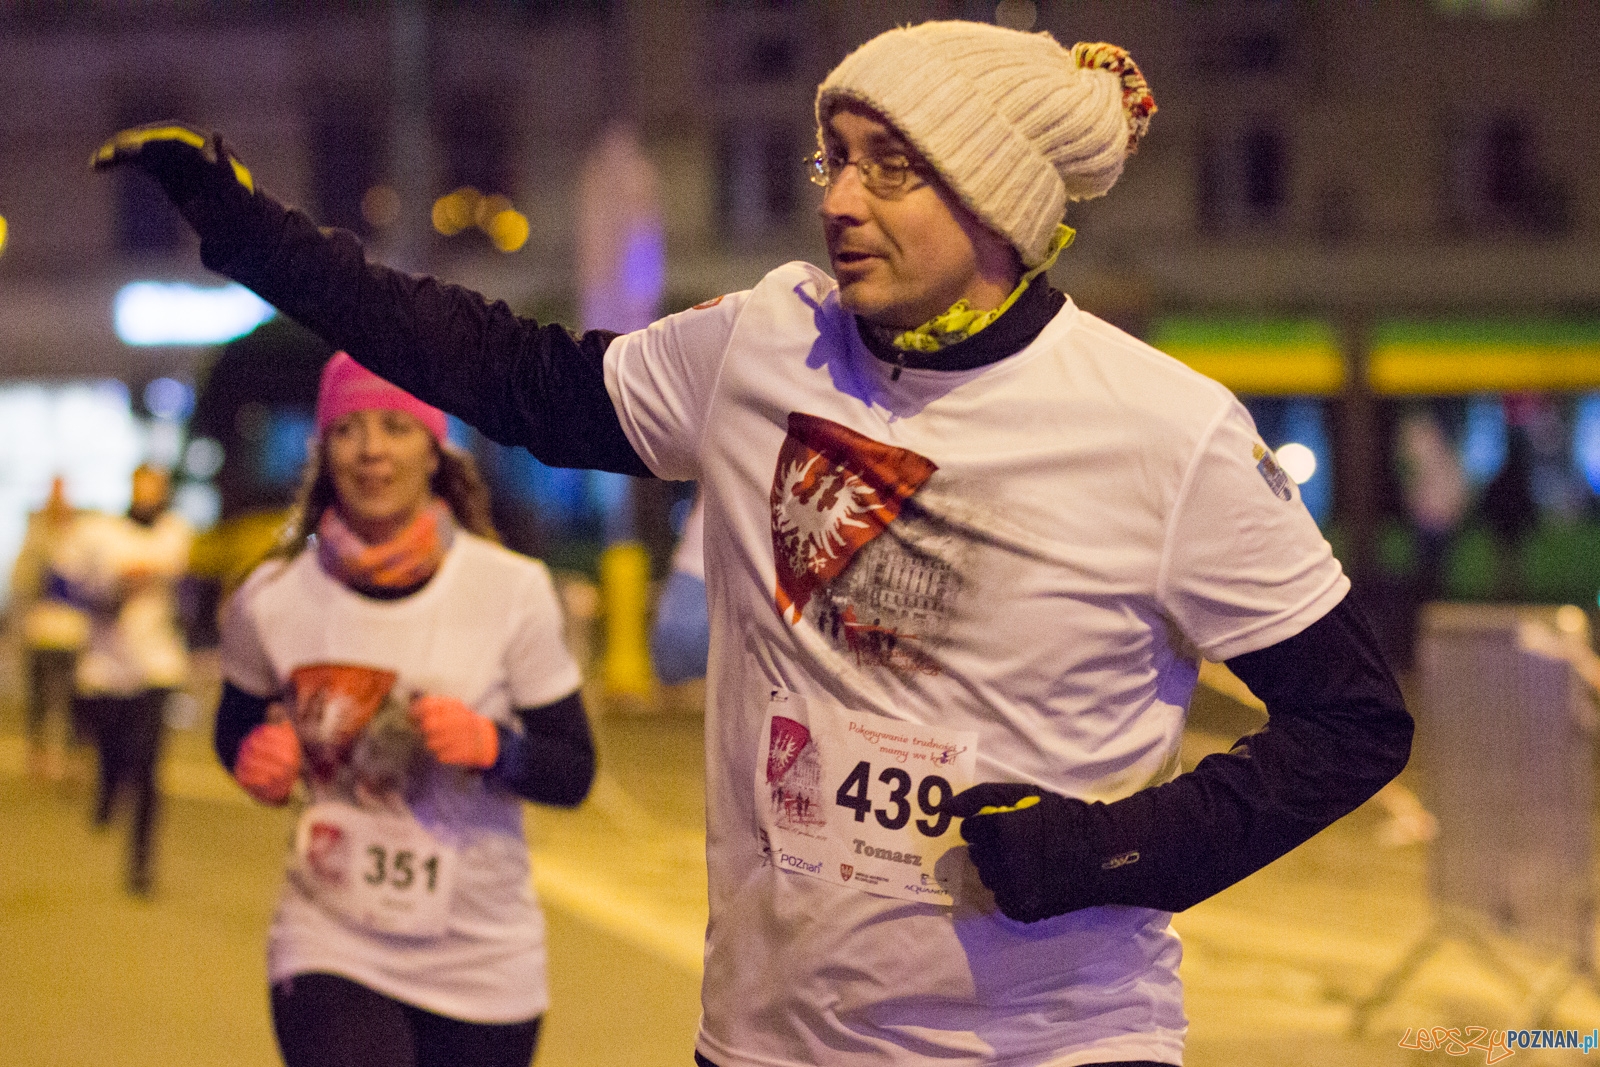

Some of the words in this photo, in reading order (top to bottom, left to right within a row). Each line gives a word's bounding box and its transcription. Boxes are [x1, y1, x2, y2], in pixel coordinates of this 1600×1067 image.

[849, 721, 908, 744] Pokonywanie
[879, 745, 908, 763] mamy
[913, 752, 926, 760] we
[836, 761, 954, 837] 439
[853, 839, 922, 866] Tomasz
[364, 844, 438, 892] 351
